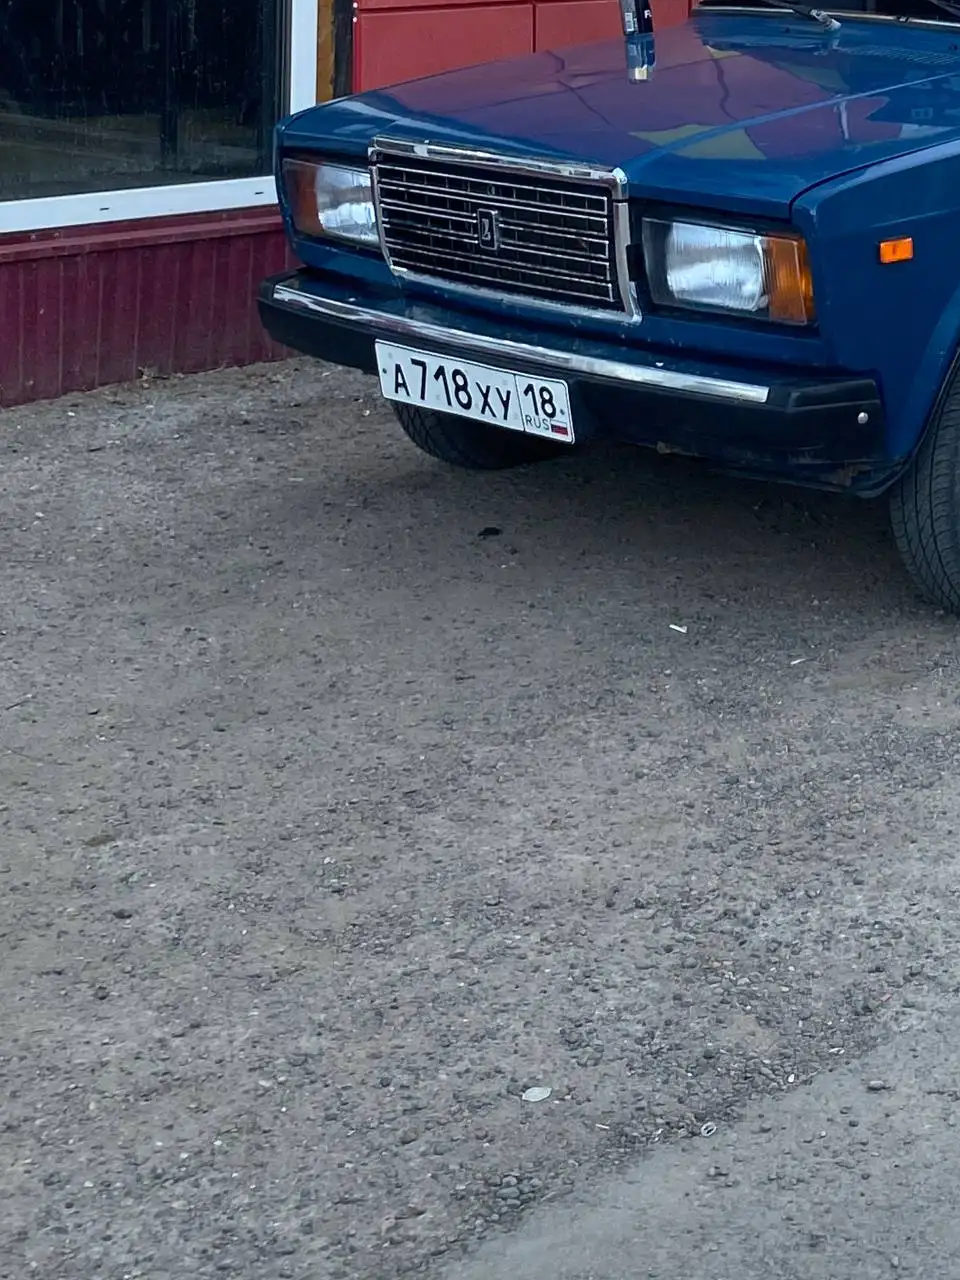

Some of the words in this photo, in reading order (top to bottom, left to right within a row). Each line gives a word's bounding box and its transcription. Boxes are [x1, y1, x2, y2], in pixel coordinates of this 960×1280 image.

[395, 358, 511, 420] А718ХУ
[523, 383, 556, 418] 18
[525, 415, 549, 431] RUS
